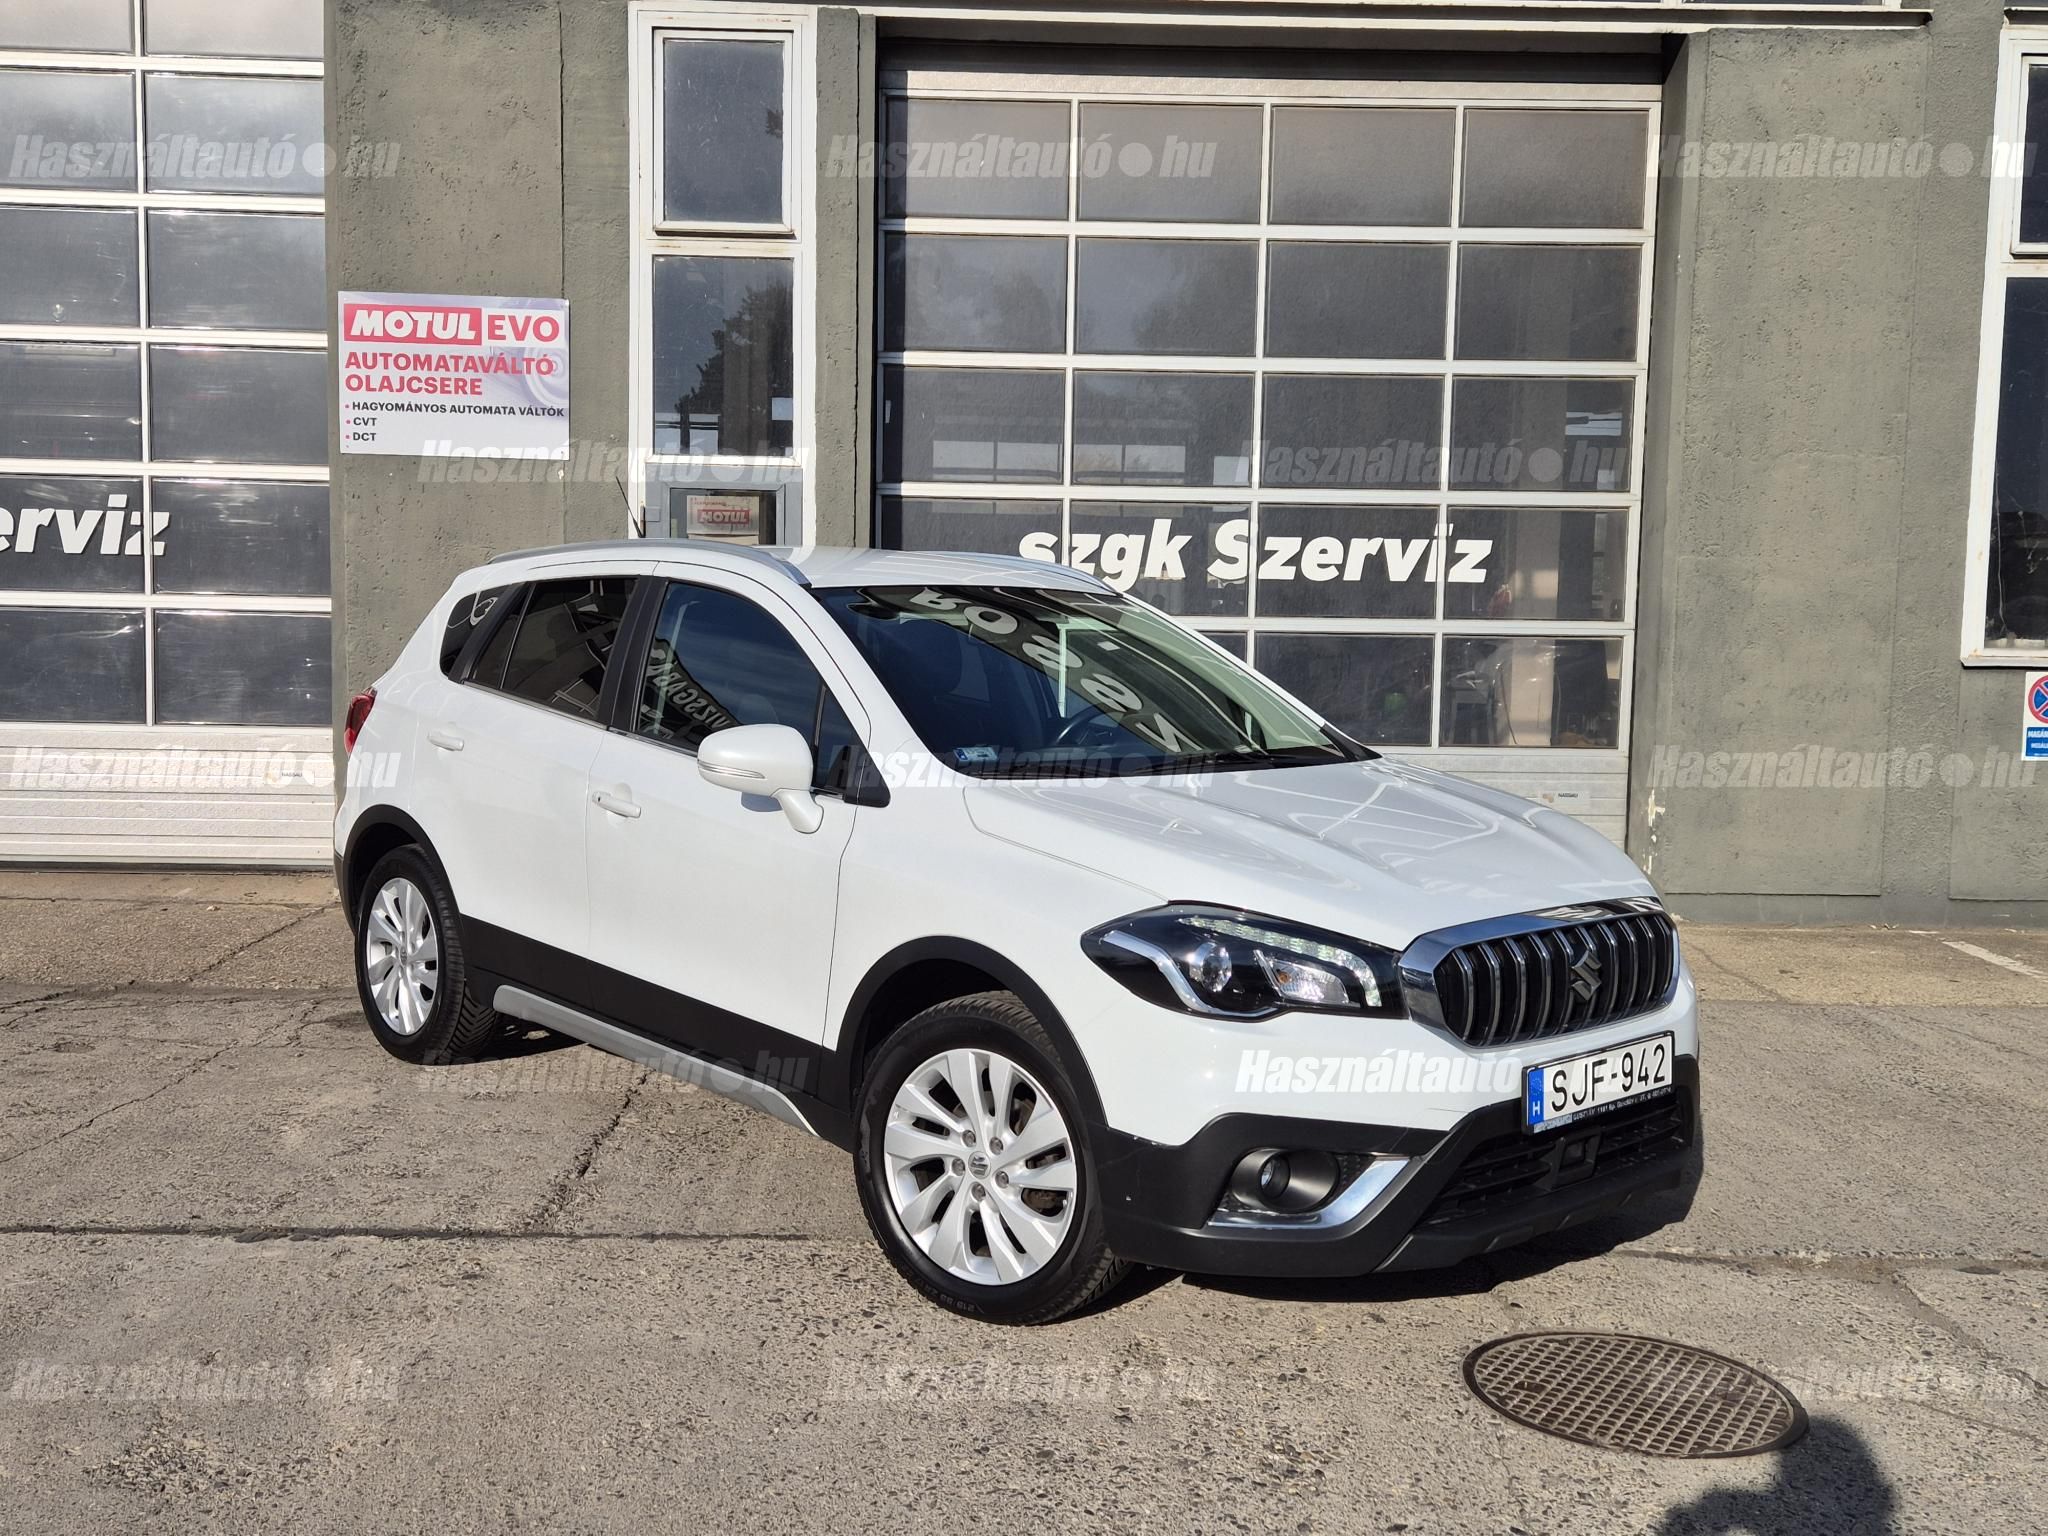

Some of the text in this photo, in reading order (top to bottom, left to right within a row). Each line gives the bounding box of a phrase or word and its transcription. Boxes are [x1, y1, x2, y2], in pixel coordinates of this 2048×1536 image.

[350, 309, 560, 342] MOTUL EVO
[345, 351, 554, 376] AUTOMATAVÁLTÓ
[345, 374, 483, 396] OLAJCSERE
[352, 401, 447, 414] HAGYOMÁNYOS
[449, 404, 516, 416] AUTOMATA
[353, 417, 378, 427] CVT
[352, 432, 377, 442] DCT
[700, 511, 747, 523] MOTUL
[1018, 518, 1494, 592] szgk Szerviz
[1551, 1043, 1667, 1112] SJF-942
[1532, 1100, 1541, 1117] H
